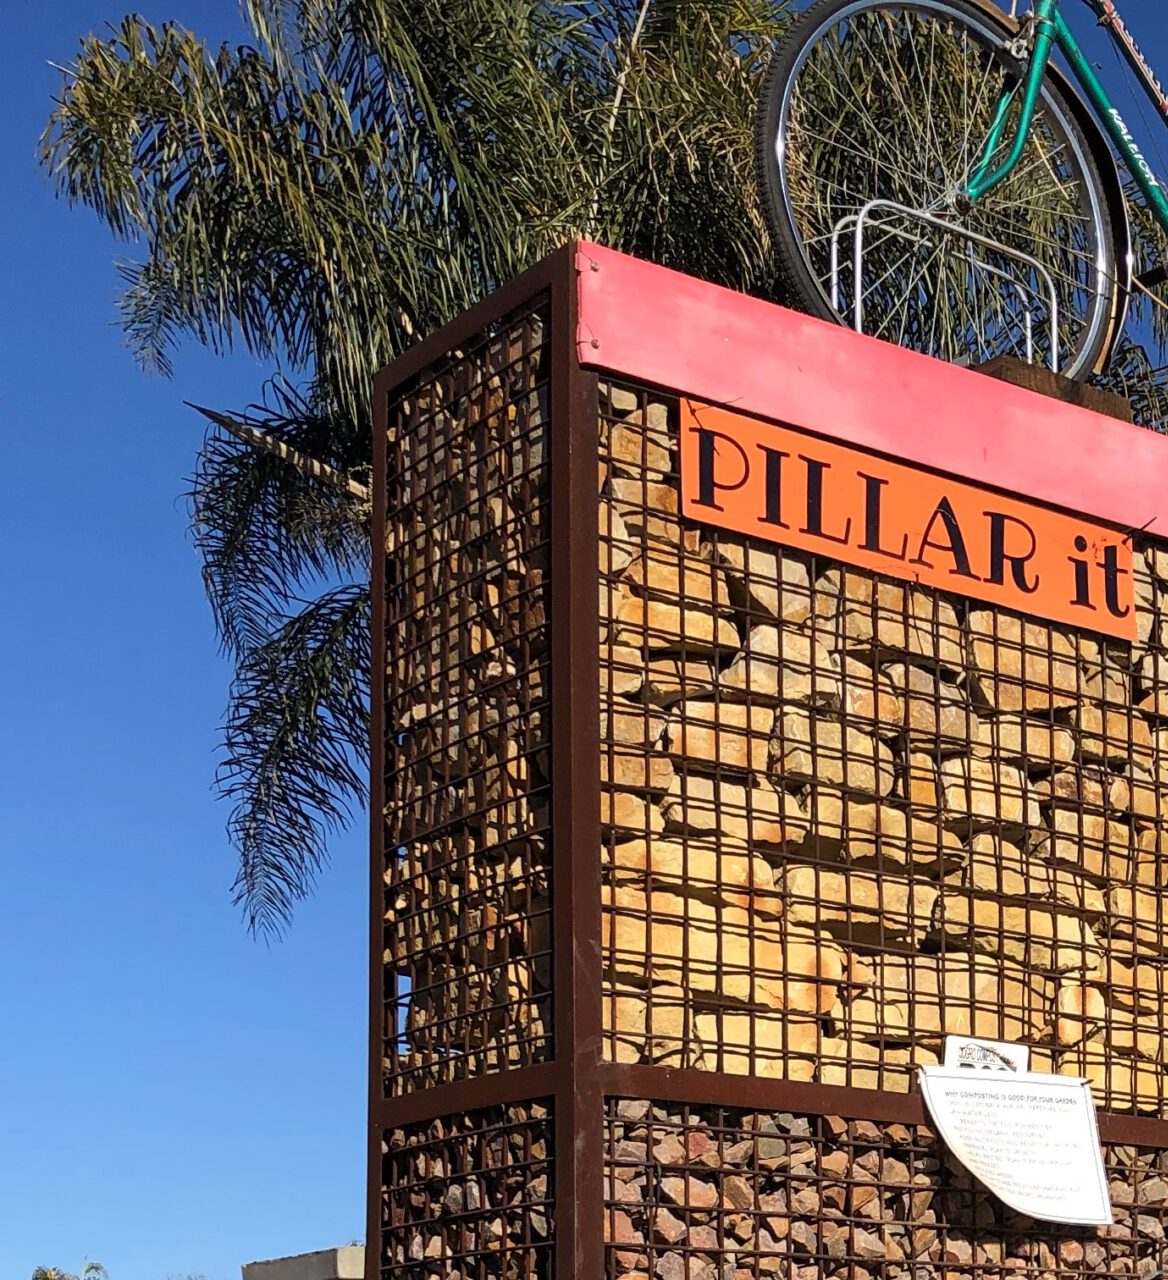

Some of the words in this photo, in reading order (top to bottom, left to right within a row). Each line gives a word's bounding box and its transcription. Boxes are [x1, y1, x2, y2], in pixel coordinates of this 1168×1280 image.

[689, 427, 1040, 594] PILLAR
[1067, 535, 1130, 618] it
[960, 1091, 999, 1100] COMPOSTING
